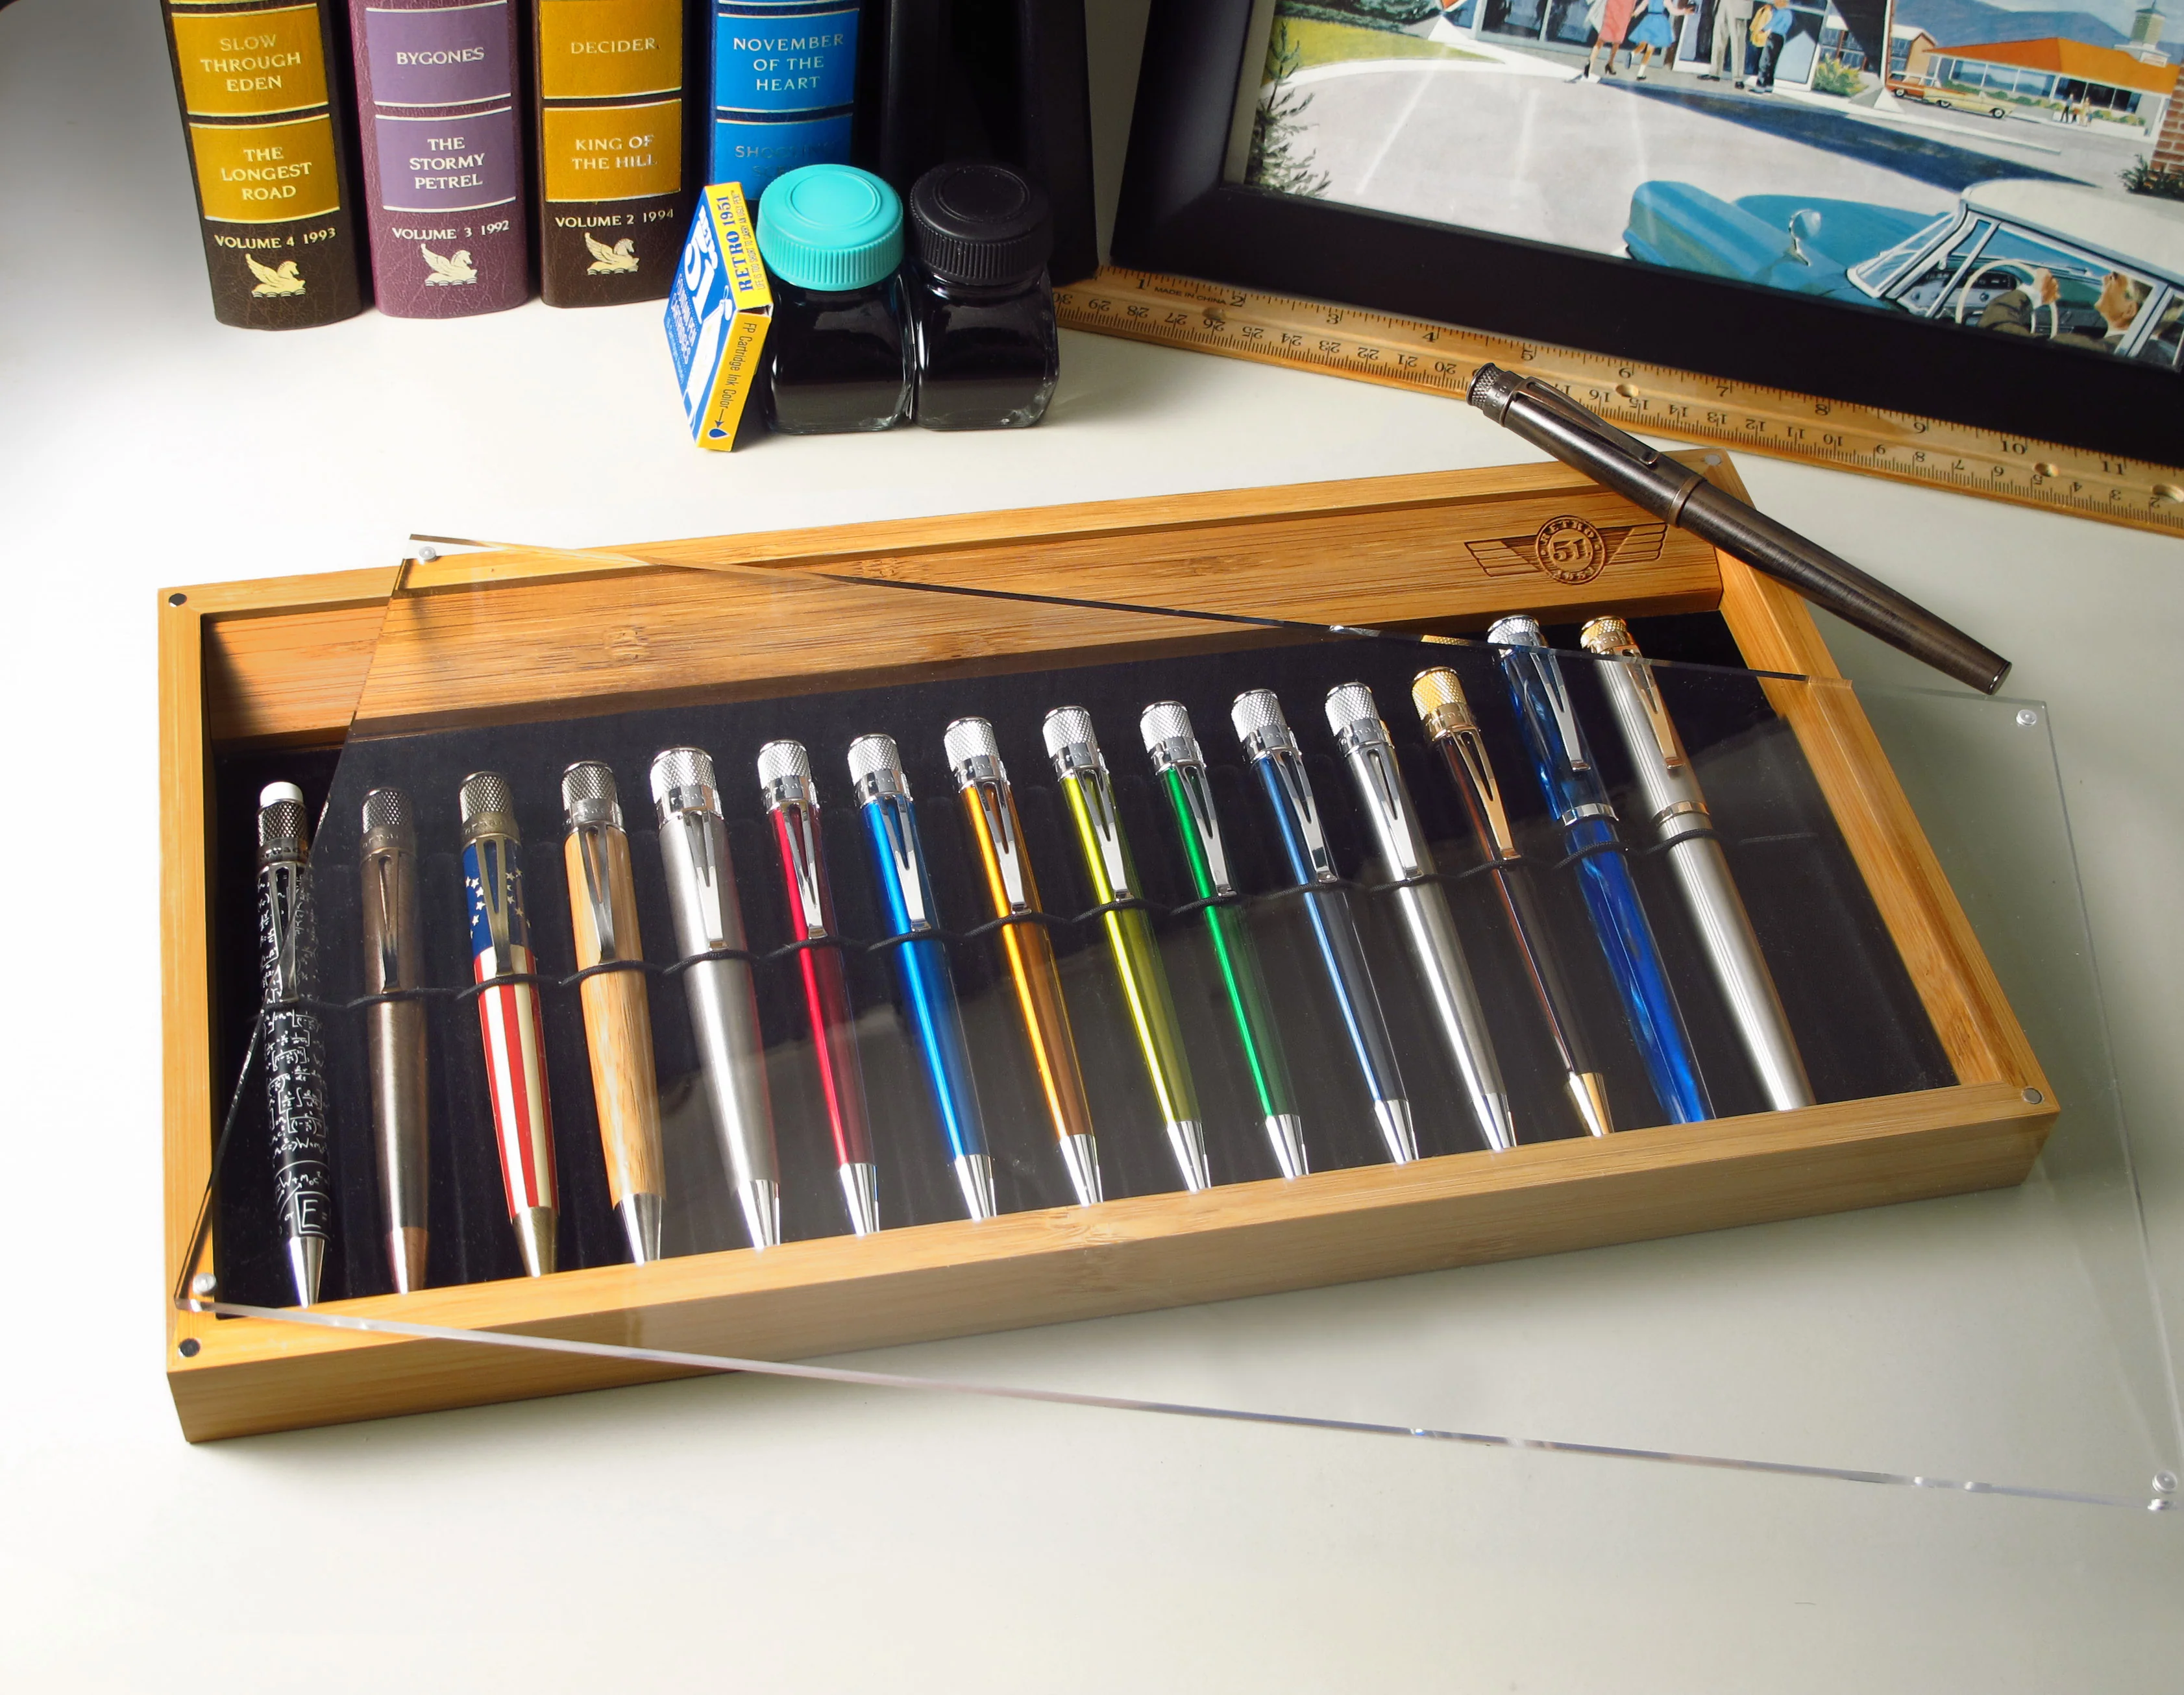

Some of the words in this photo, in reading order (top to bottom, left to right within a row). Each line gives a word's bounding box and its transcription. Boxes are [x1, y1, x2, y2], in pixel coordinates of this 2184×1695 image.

[219, 34, 277, 52] SLOW
[571, 37, 656, 55] DECIDER
[733, 34, 844, 51] NOVEMBER
[201, 52, 301, 73] THROUGH
[396, 47, 485, 66] BYGONES
[753, 58, 779, 71] OF
[787, 56, 824, 71] THE
[227, 75, 282, 92] EDEN
[756, 76, 820, 91] HEART
[427, 137, 465, 151] THE
[575, 137, 623, 152] KING
[628, 134, 654, 150] OF
[243, 147, 284, 162] THE
[409, 152, 485, 171] STORMY
[572, 156, 610, 171] THE
[615, 153, 657, 169] HILL
[221, 162, 312, 182] LONGEST
[414, 173, 483, 190] PETREL
[242, 184, 297, 201] ROAD
[555, 214, 621, 228] VOLUME
[626, 213, 635, 225] 2
[643, 208, 674, 225] 1994
[717, 196, 736, 226] 1951
[214, 234, 282, 250] VOLUME
[286, 236, 295, 247] 4
[303, 227, 337, 245] 1993
[392, 226, 458, 241] VOLUME
[464, 226, 473, 239] 3
[481, 220, 510, 236] 1992
[726, 231, 754, 293] RETRO
[684, 220, 715, 324] 51
[1154, 286, 1182, 297] MADE
[1196, 295, 1226, 306] CHINA
[743, 322, 757, 334] FP
[729, 336, 753, 371] Cartridge
[726, 374, 741, 385] Ink
[1136, 278, 1145, 290] 1
[1229, 295, 1245, 308] 2
[1327, 313, 1340, 324] 3
[1422, 331, 1436, 343] 4
[1521, 349, 1534, 361] 5
[1619, 367, 1631, 379] 6
[1716, 385, 1730, 397] 7
[1815, 404, 1828, 416] 8
[1913, 421, 1926, 433] 9
[2000, 440, 2026, 455] 10
[2102, 460, 2124, 475] 11
[719, 389, 737, 409] Color
[1088, 299, 1111, 311] 29
[1127, 305, 1149, 318] 28
[1164, 312, 1188, 325] 27
[1203, 319, 1226, 332] 26
[1242, 326, 1264, 339] 25
[1281, 332, 1303, 347] 24
[1319, 340, 1341, 353] 23
[1358, 347, 1380, 360] 22
[1398, 354, 1418, 367] 21
[1434, 361, 1456, 374] 20
[1589, 389, 1610, 403] 16
[1629, 397, 1649, 410] 15
[1669, 404, 1689, 418] 14
[1707, 411, 1727, 425] 13
[1745, 419, 1766, 432] 12
[1787, 426, 1806, 439] 11
[1823, 433, 1843, 447] 10
[1915, 451, 1926, 463] 8
[1954, 459, 1965, 471] 7
[2033, 474, 2043, 485] 5
[2071, 482, 2083, 493] 4
[2110, 489, 2122, 501] 3
[1540, 519, 1597, 544] RETRO
[1553, 539, 1588, 562] 51
